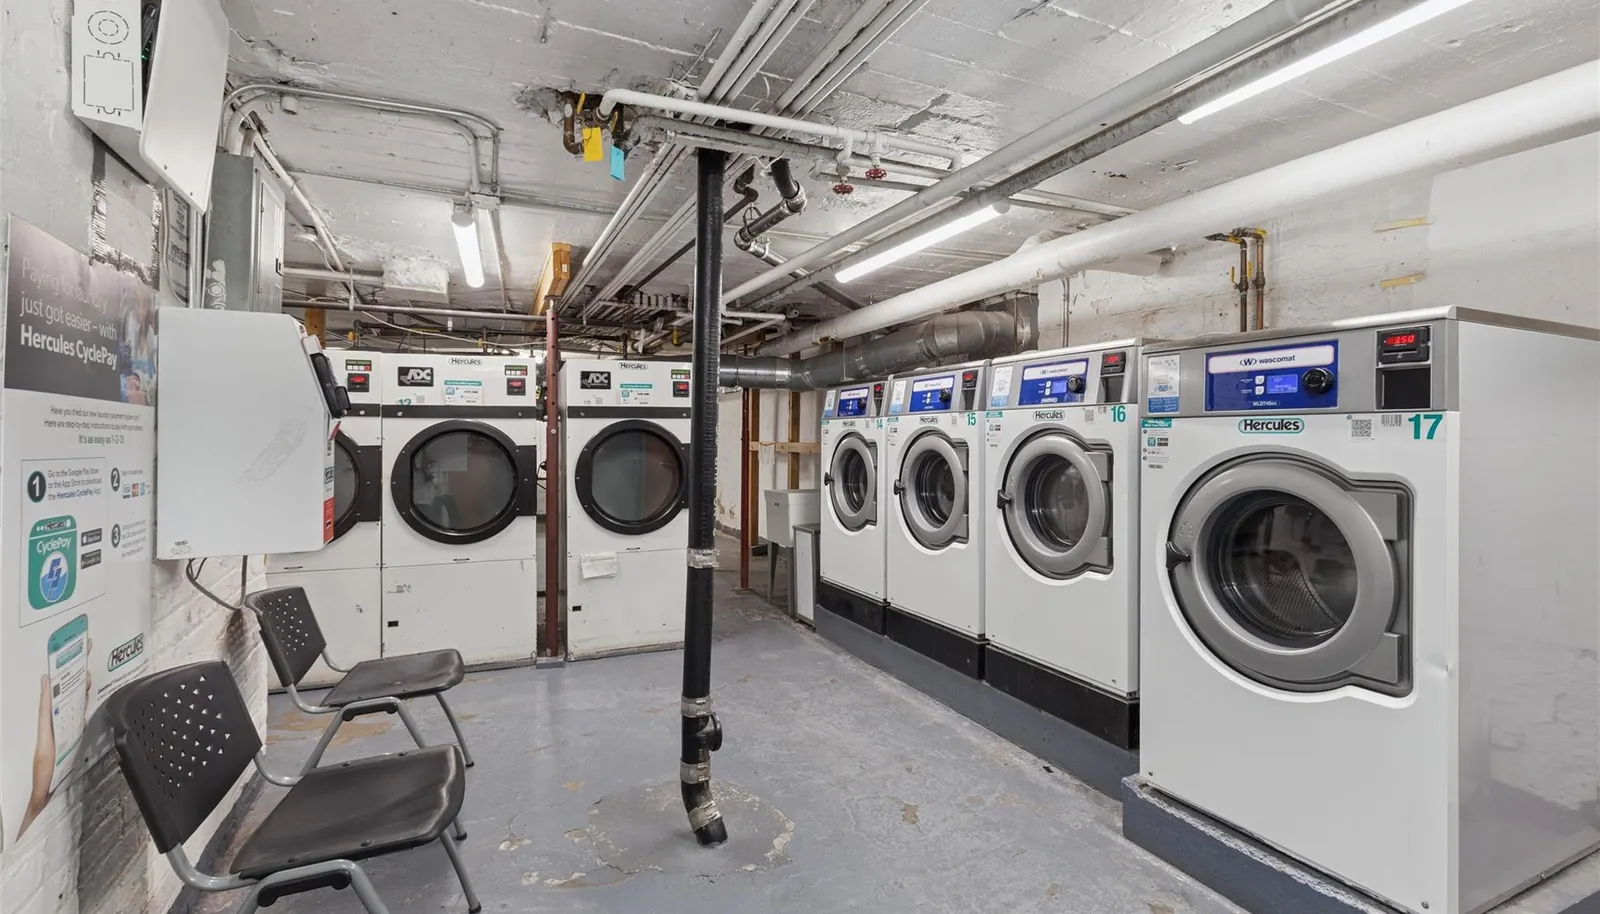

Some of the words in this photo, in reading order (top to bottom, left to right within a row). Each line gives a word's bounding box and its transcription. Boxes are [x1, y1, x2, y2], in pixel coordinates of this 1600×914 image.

[22, 257, 59, 294] Paying
[61, 274, 76, 295] for
[76, 281, 108, 315] laundry
[20, 291, 44, 317] just
[45, 304, 64, 326] got
[65, 311, 92, 333] easier
[99, 322, 118, 341] with
[20, 323, 76, 357] Hercules
[76, 340, 118, 371] CyclePay
[451, 357, 482, 366] Hercules
[620, 362, 647, 370] Hercules
[1258, 355, 1296, 364] wascomat
[407, 368, 431, 381] ADC
[587, 372, 609, 384] ADC
[919, 416, 939, 425] Hercules
[967, 412, 977, 426] 15
[1035, 410, 1064, 420] Hercules
[1111, 405, 1126, 423] 16
[44, 418, 57, 428] Here
[876, 419, 884, 430] 14
[1243, 419, 1300, 432] Hercules
[1408, 414, 1444, 440] 17
[48, 469, 56, 478] Go
[68, 468, 82, 478] Google
[112, 470, 119, 487] 2
[32, 475, 40, 497] 1
[48, 481, 53, 489] or
[53, 480, 61, 489] the
[61, 479, 71, 489] App
[71, 479, 81, 488] Store
[48, 491, 56, 500] the
[56, 490, 76, 500] Hercules
[113, 527, 119, 545] 3
[36, 536, 72, 556] CyclePay
[110, 635, 143, 668] Hercules
